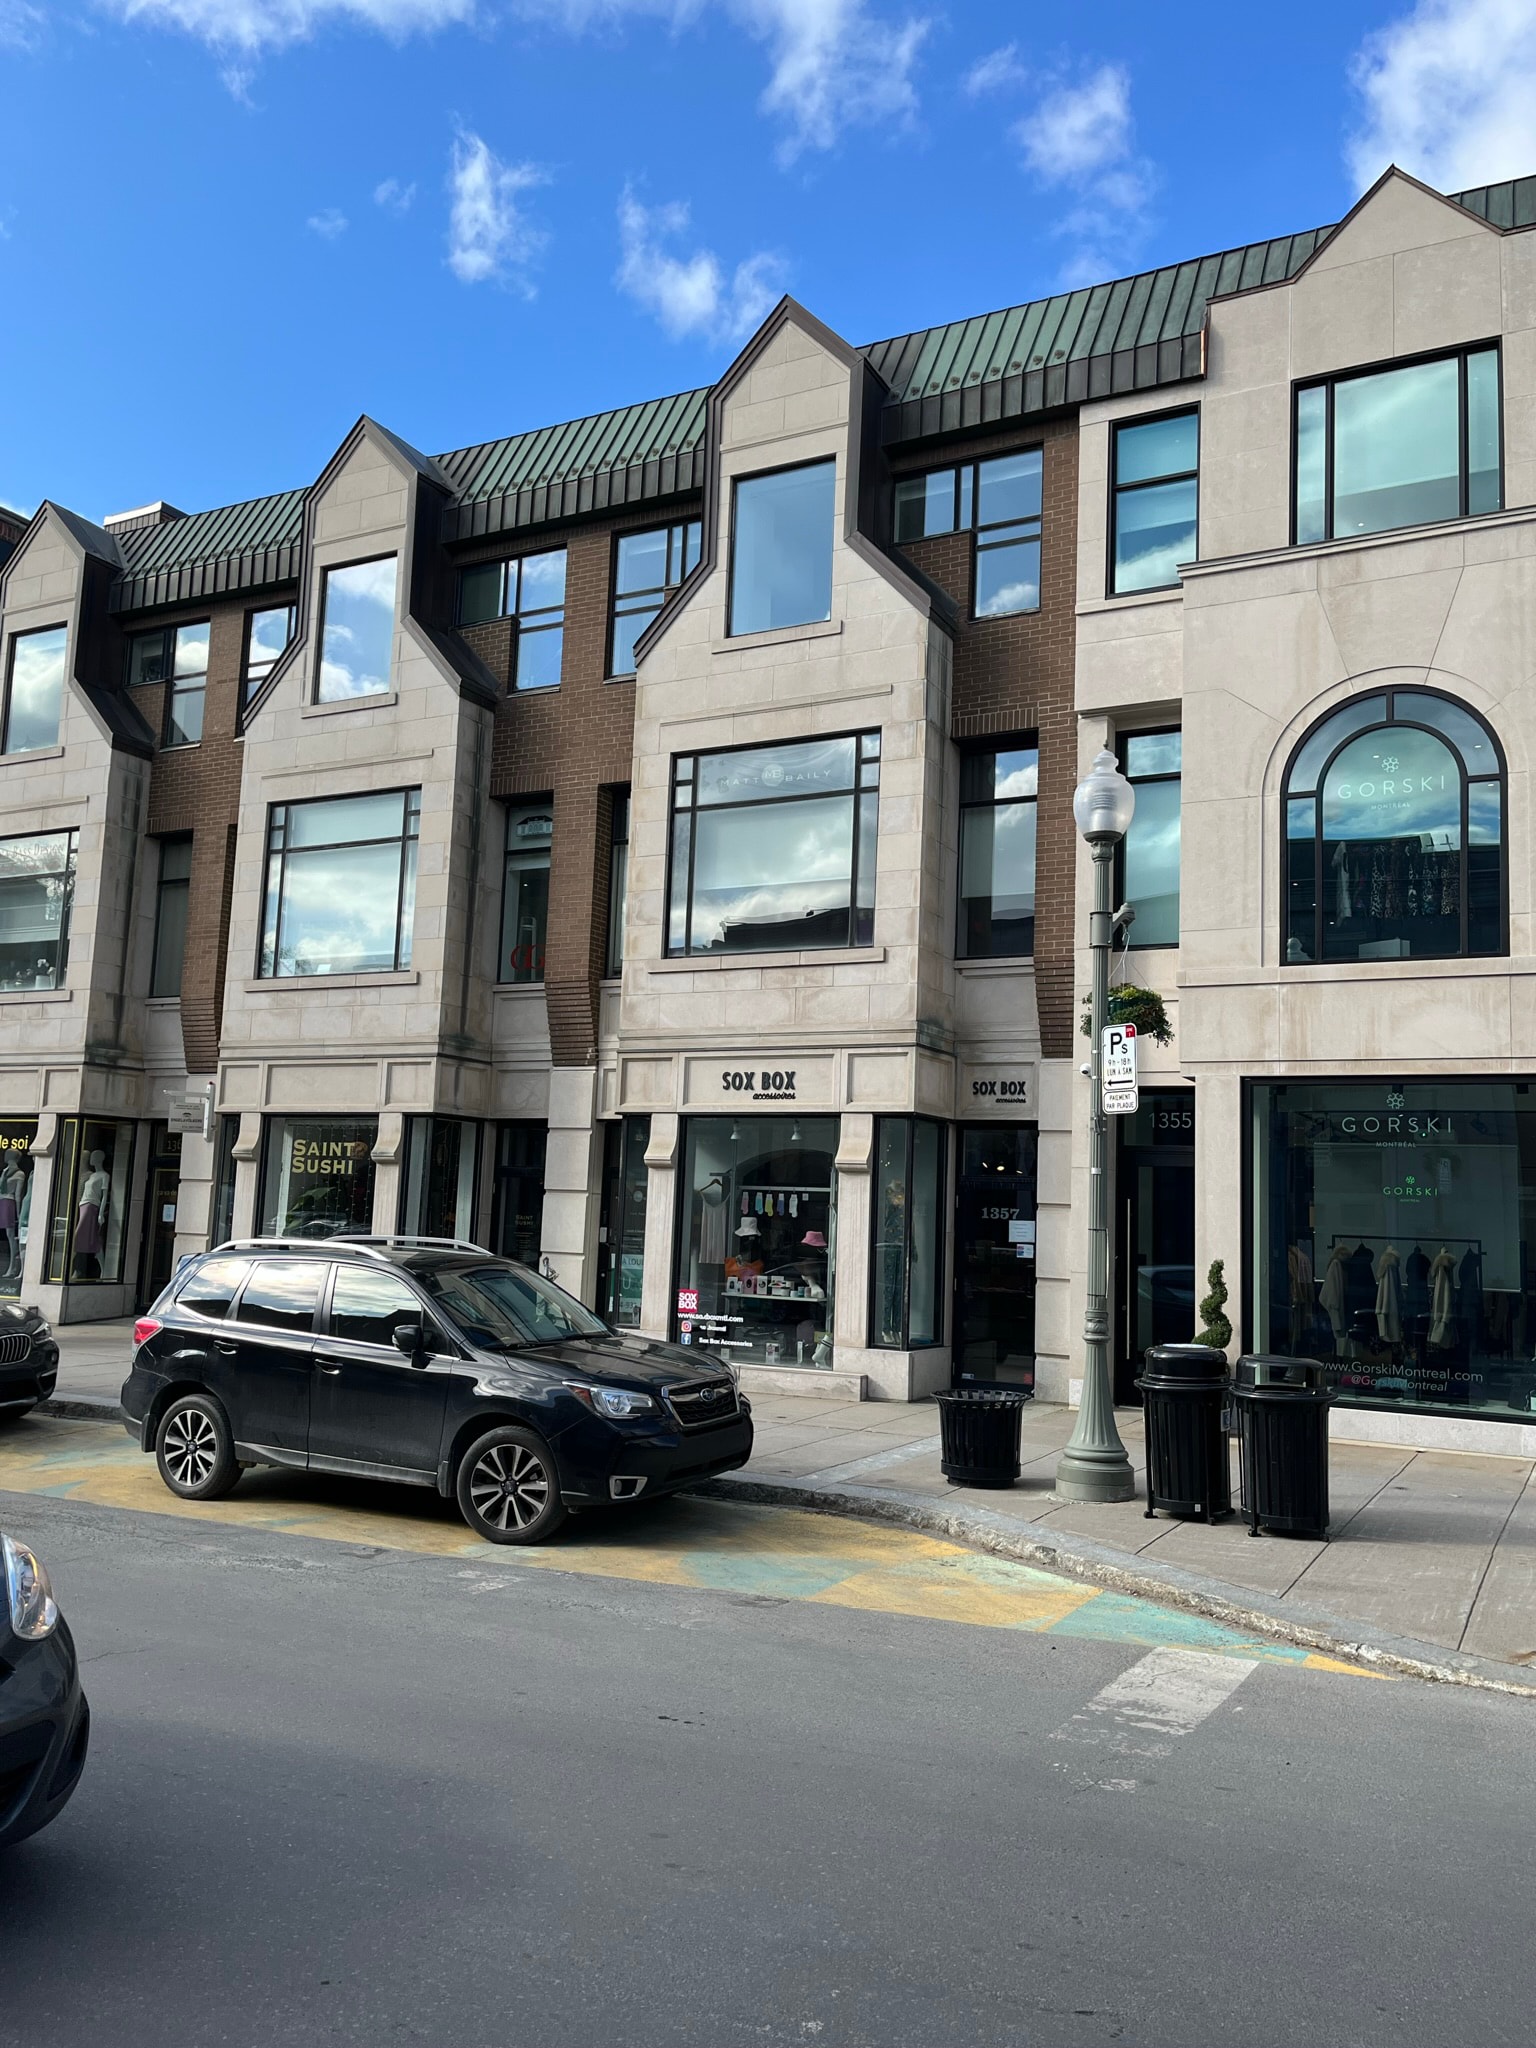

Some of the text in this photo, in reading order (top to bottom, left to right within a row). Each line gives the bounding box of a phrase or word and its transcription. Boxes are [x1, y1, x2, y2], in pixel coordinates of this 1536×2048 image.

[785, 769, 831, 782] BAILY
[1337, 775, 1445, 799] GORSKI
[722, 1071, 796, 1091] SOX BOX
[972, 1080, 1026, 1096] SOX BOX
[752, 1091, 796, 1100] accessoires
[1148, 1112, 1192, 1129] 1355
[1341, 1116, 1451, 1133] GORSKI
[11, 1135, 29, 1150] soi
[292, 1139, 356, 1157] SAINT
[291, 1156, 353, 1175] SUSHI
[1382, 1186, 1438, 1196] GORSKI
[981, 1207, 1020, 1220] 1357
[678, 1292, 698, 1301] SOX
[678, 1300, 698, 1310] BOX
[1351, 1374, 1448, 1392] @GorskiMontreal
